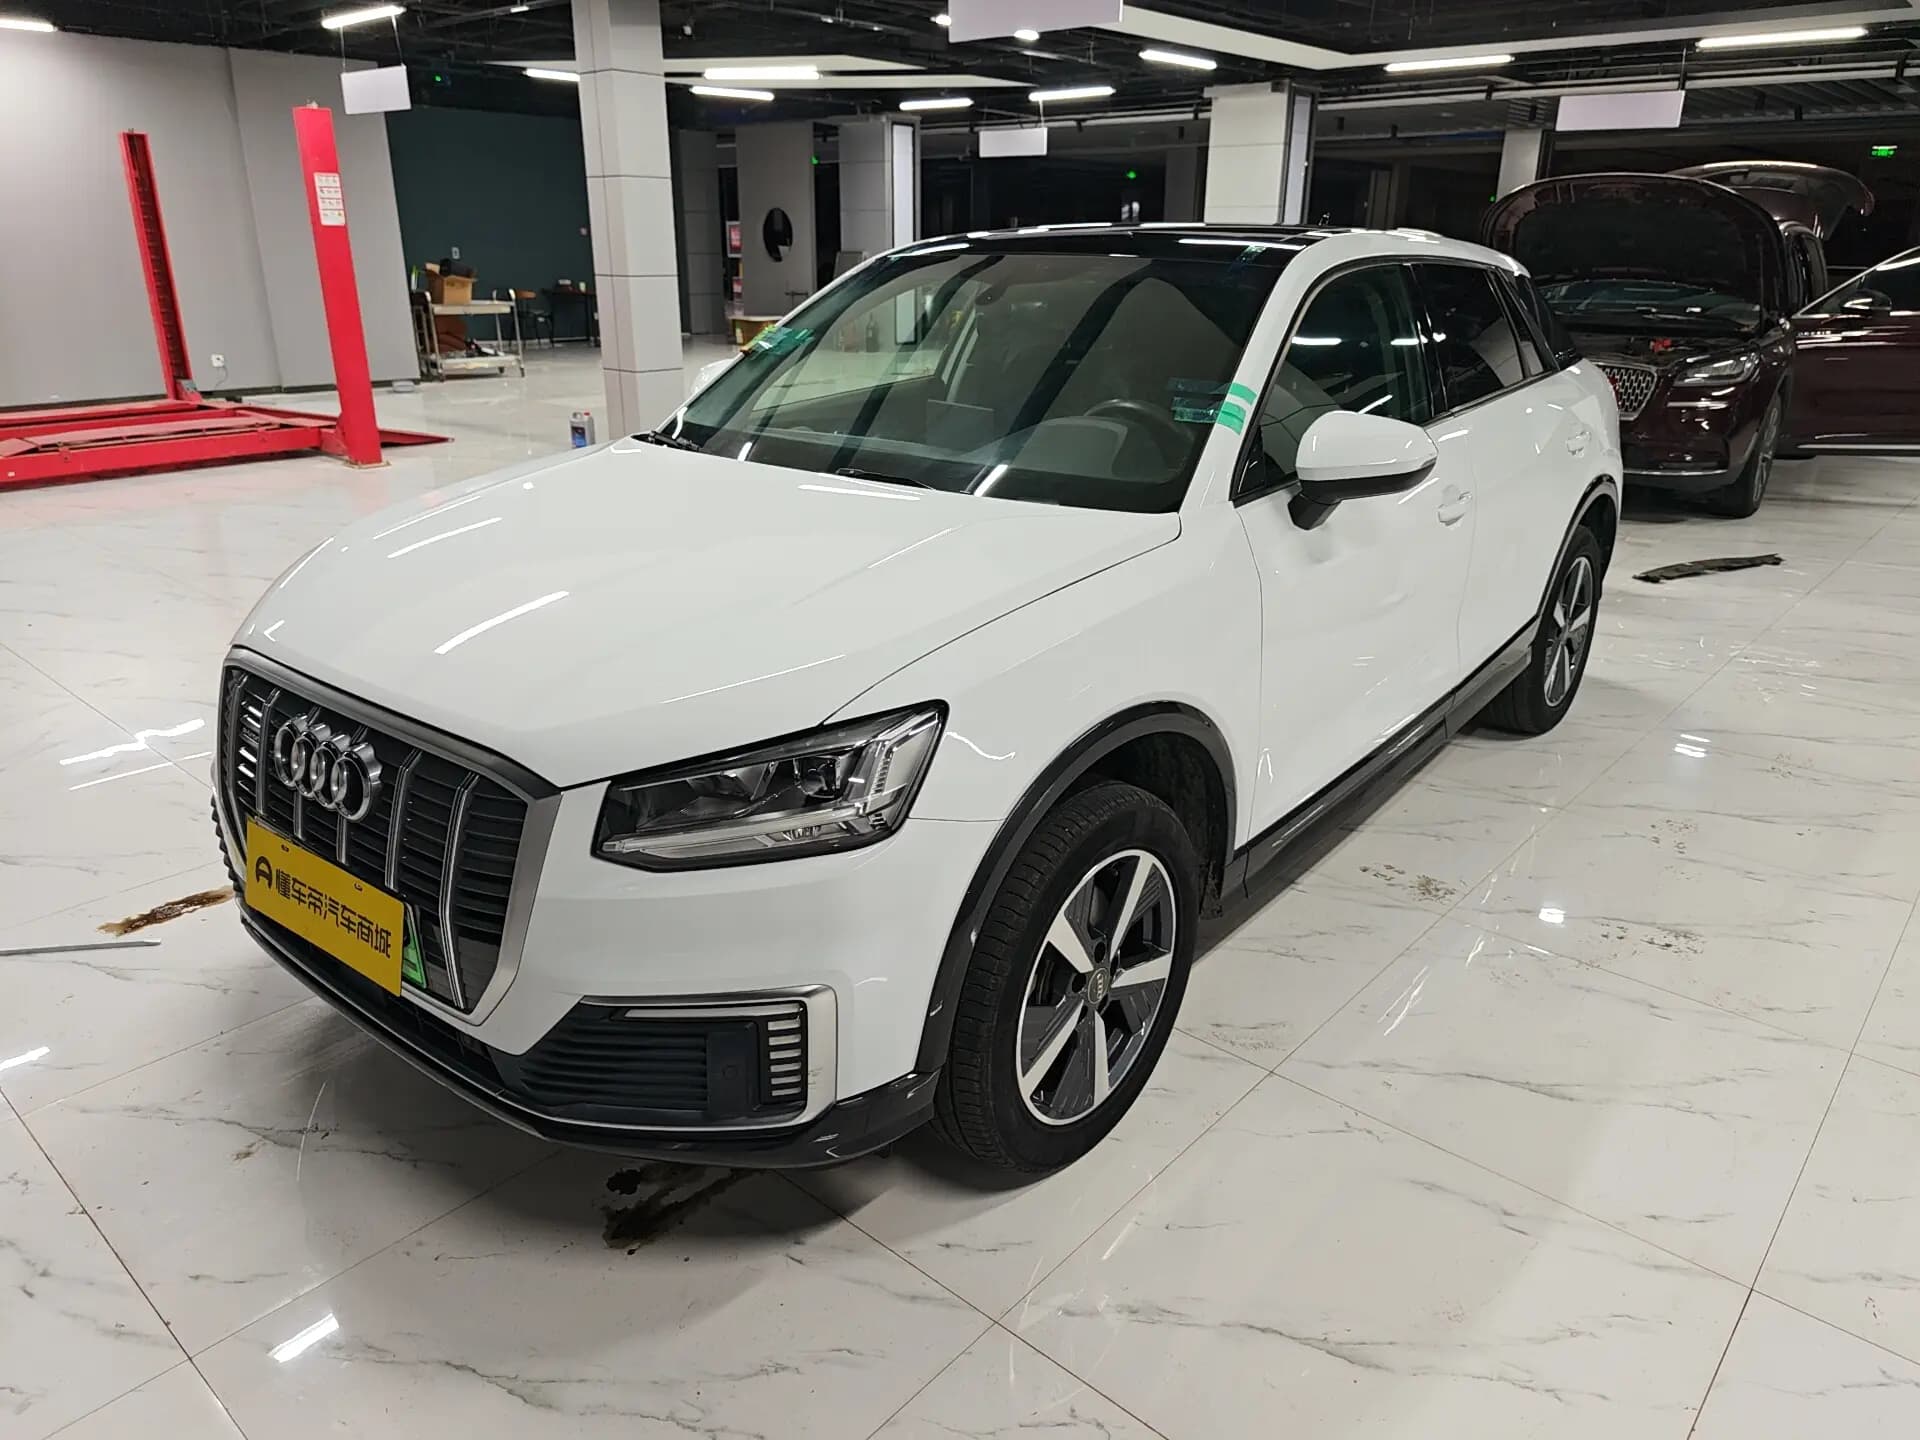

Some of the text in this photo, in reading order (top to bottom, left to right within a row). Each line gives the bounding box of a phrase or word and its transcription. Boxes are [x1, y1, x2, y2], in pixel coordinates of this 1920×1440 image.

[276, 868, 392, 959] 懂车帝汽车商城
